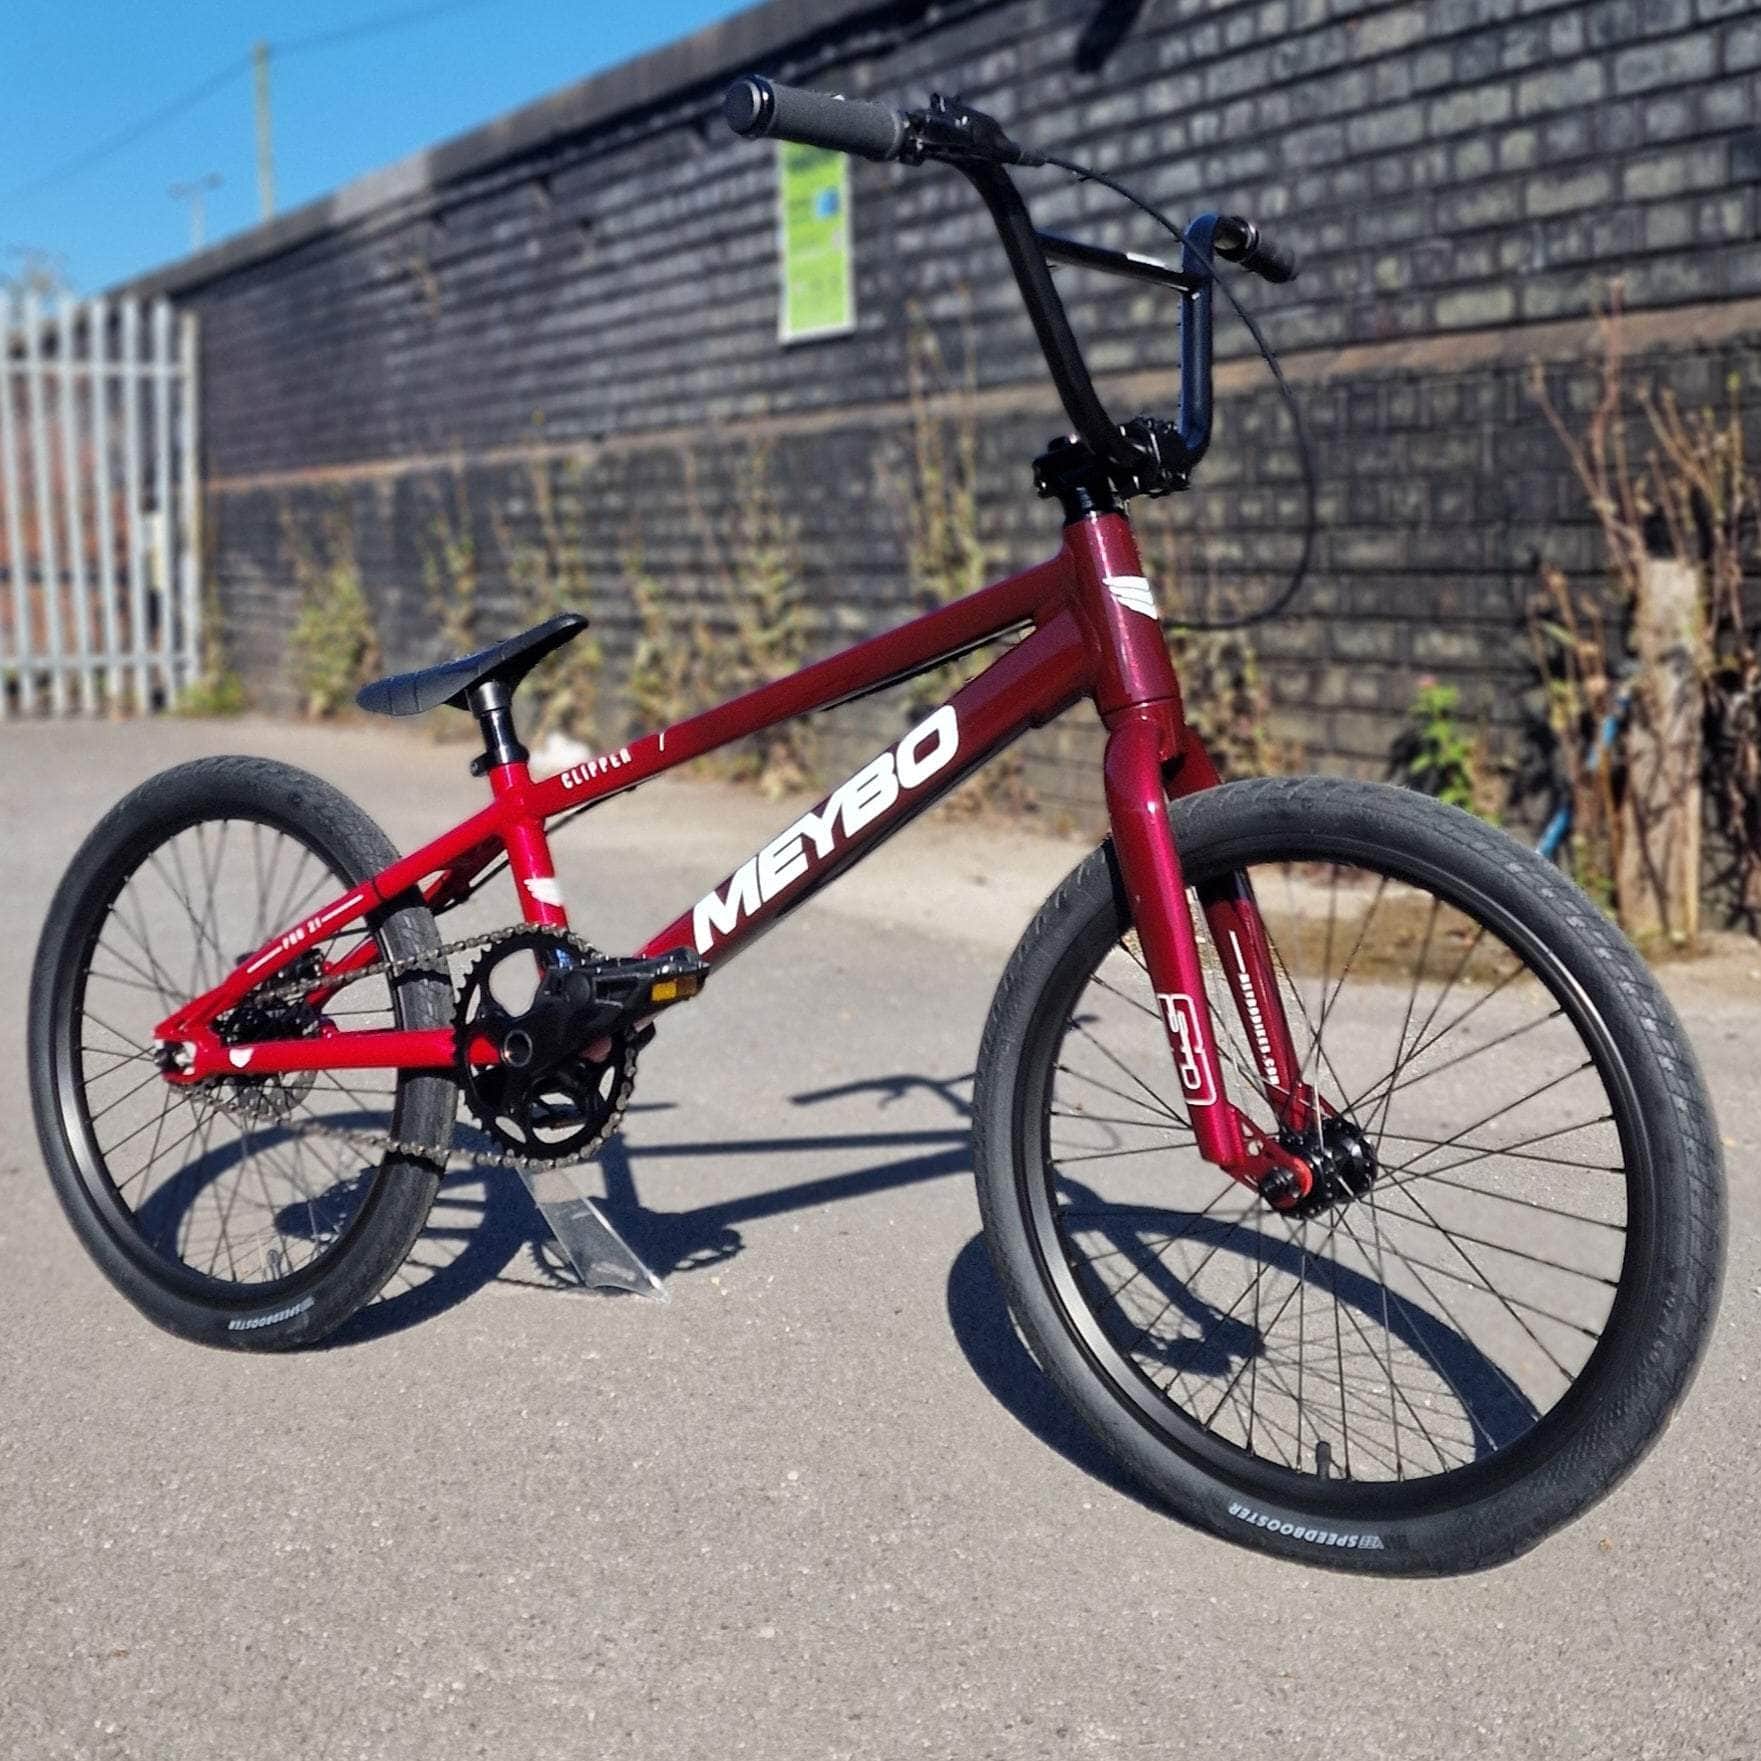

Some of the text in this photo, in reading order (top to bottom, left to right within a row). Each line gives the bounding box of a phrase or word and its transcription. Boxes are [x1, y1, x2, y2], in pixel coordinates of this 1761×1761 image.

[561, 747, 632, 789] CLIPPER
[693, 704, 960, 956] MEYBO
[1228, 1502, 1359, 1548] SPEEDBOOSTER
